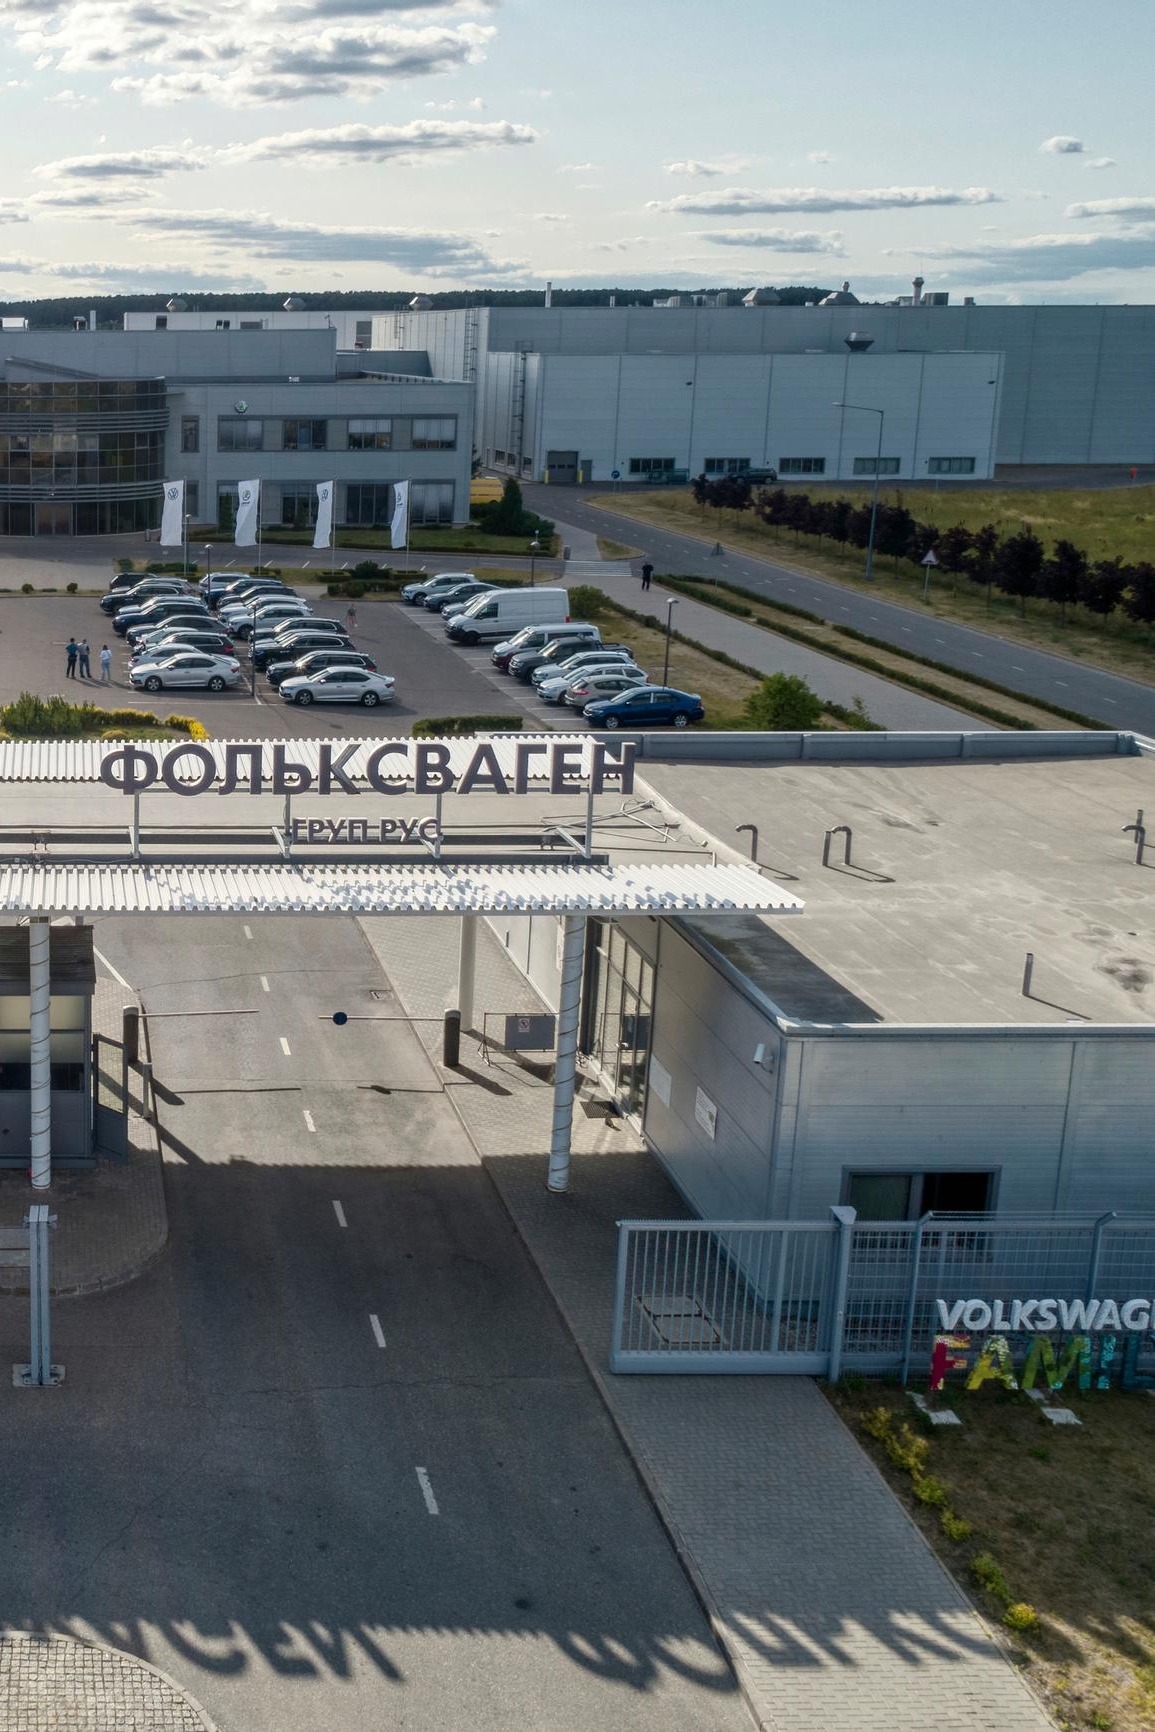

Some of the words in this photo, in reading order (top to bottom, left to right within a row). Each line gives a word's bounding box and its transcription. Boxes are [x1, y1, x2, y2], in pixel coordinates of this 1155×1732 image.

[99, 742, 636, 796] ФОЛЬКСВАГЕН
[292, 817, 368, 843] ГРУП
[379, 816, 441, 843] РУС
[929, 1334, 1155, 1390] FAMIL
